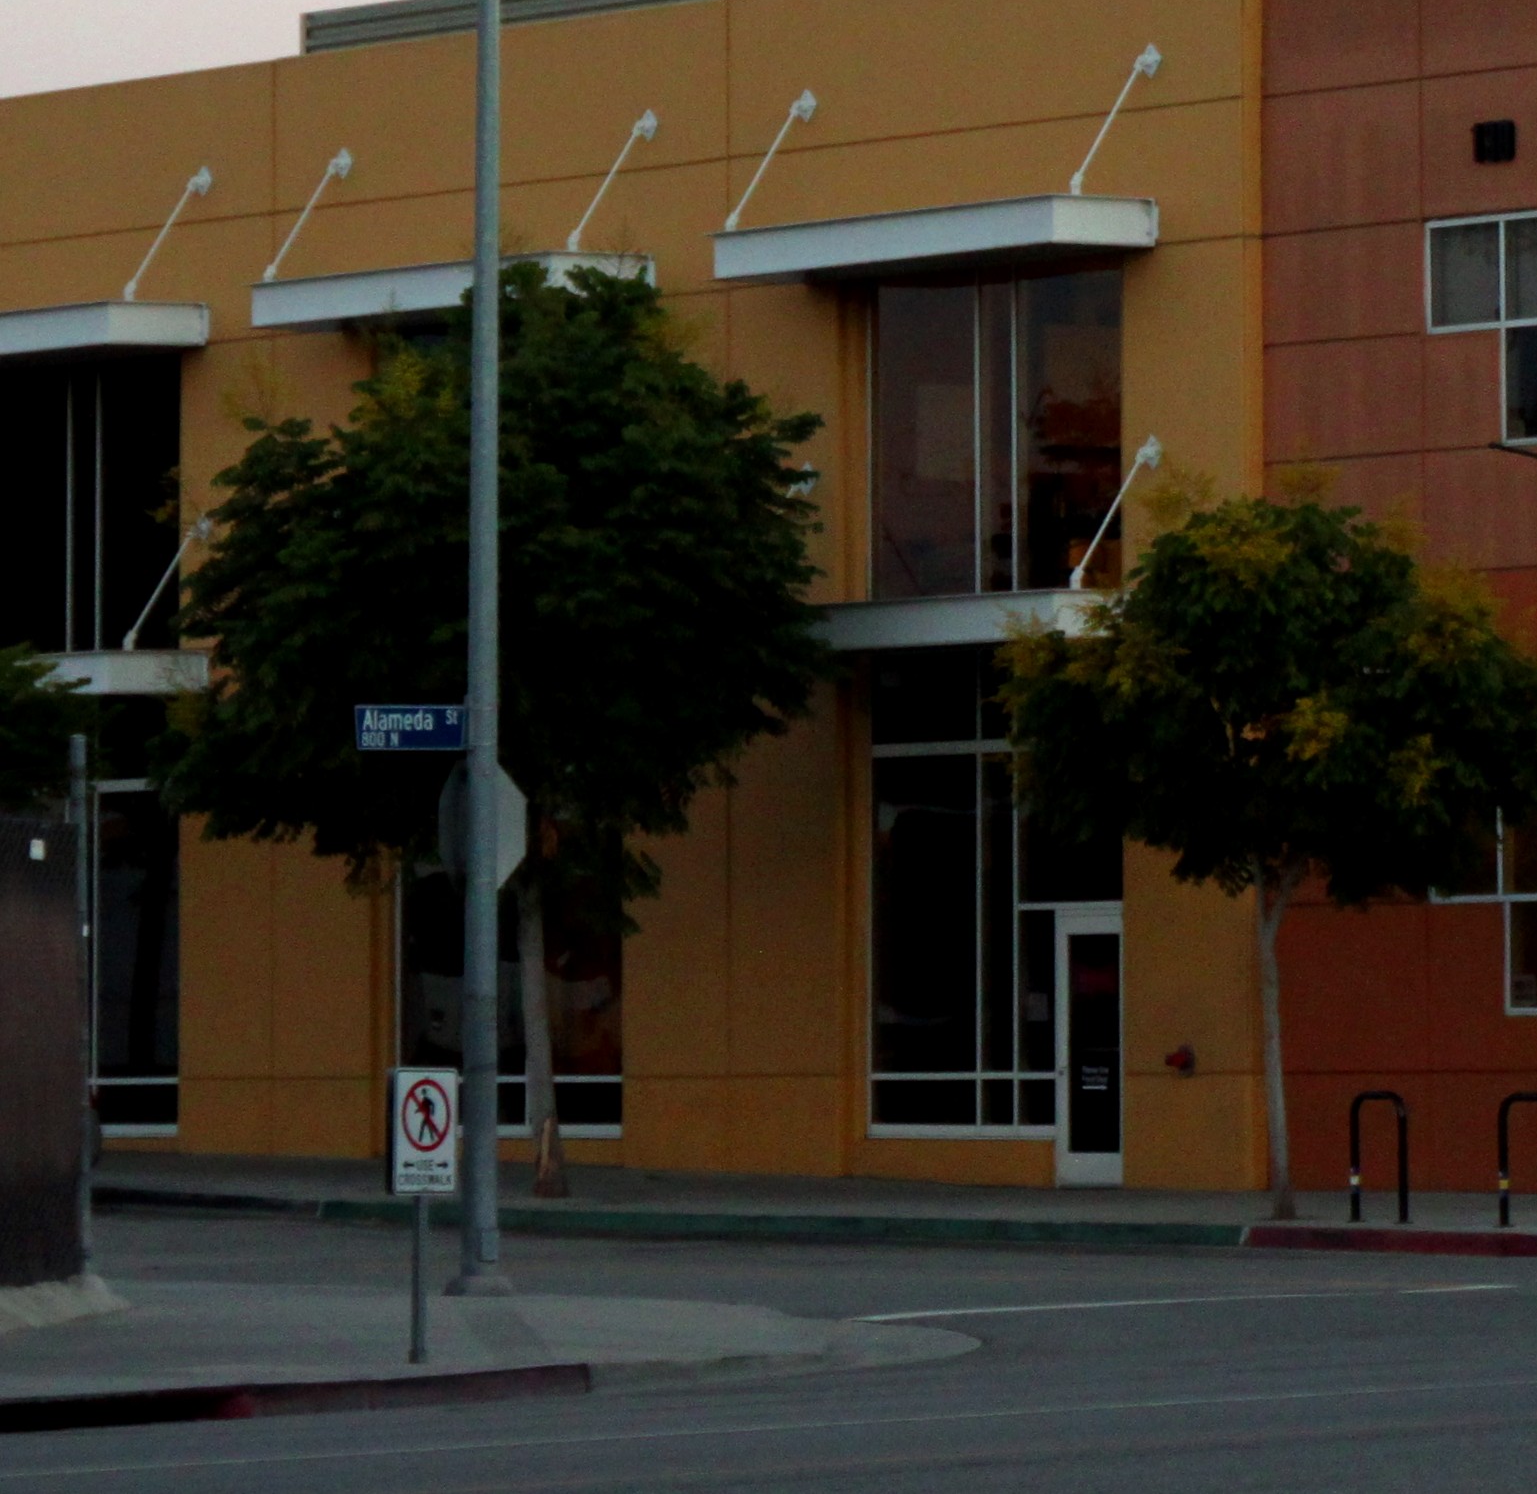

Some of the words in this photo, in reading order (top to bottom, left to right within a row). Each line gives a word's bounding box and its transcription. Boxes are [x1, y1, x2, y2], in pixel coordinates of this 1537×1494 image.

[362, 709, 435, 731] Alameda
[445, 709, 458, 725] St
[361, 731, 387, 747] 800
[388, 731, 400, 747] N
